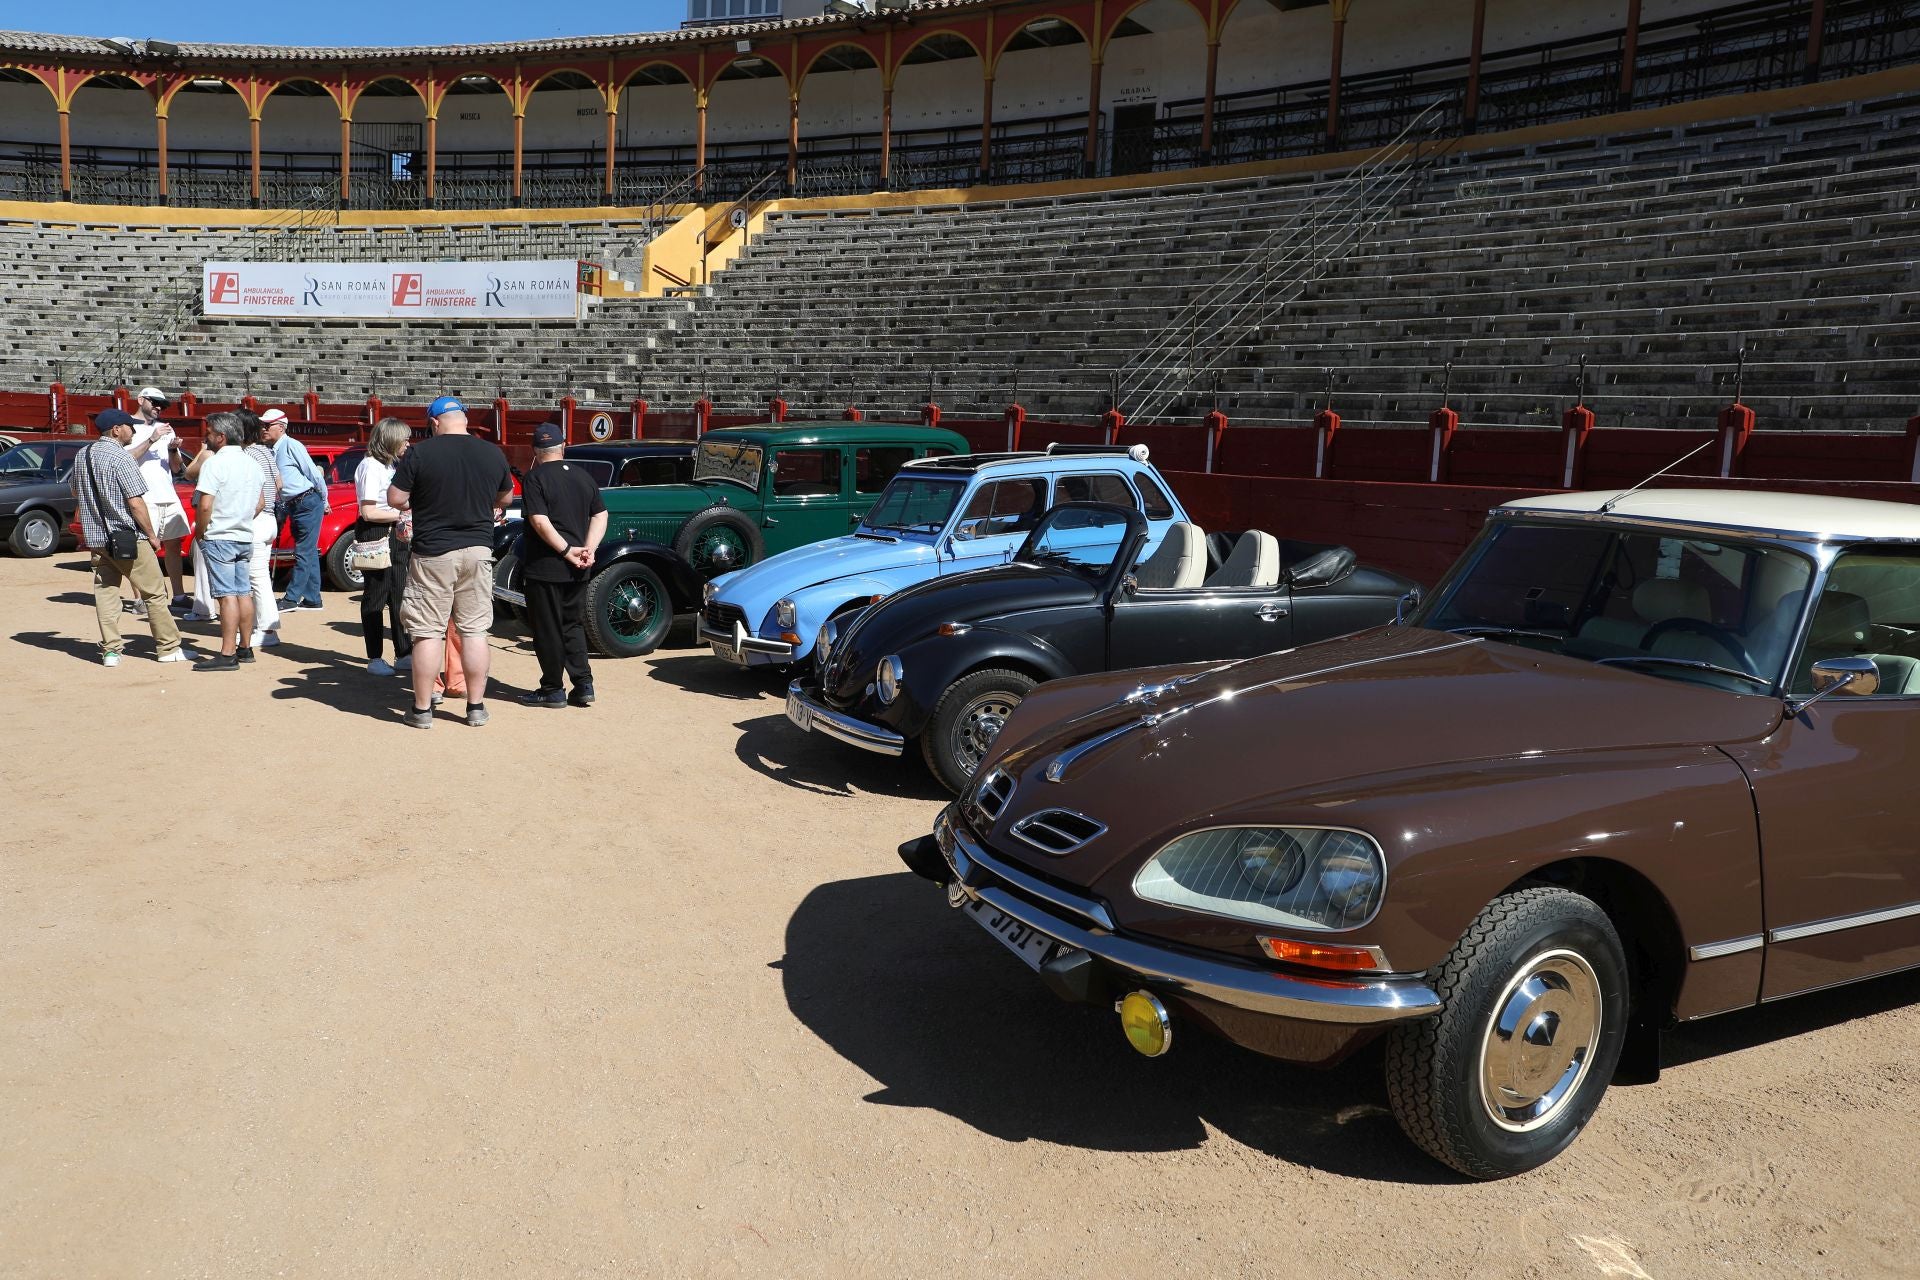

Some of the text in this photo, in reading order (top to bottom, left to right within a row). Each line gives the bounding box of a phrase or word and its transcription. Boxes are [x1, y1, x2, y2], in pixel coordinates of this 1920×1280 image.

[1120, 86, 1151, 95] GRADAS
[459, 112, 481, 121] MUSICA
[577, 107, 598, 116] MUSICA
[734, 211, 742, 226] 4
[321, 278, 386, 291] SAN ROMÁN
[503, 277, 570, 291] SAN ROMÁN
[243, 287, 285, 295] AMBULANCIAS
[425, 288, 467, 296] AMBULANCIAS
[243, 296, 296, 306] FINISTERRE
[425, 297, 477, 307] FINISTERRE
[594, 418, 607, 436] 4
